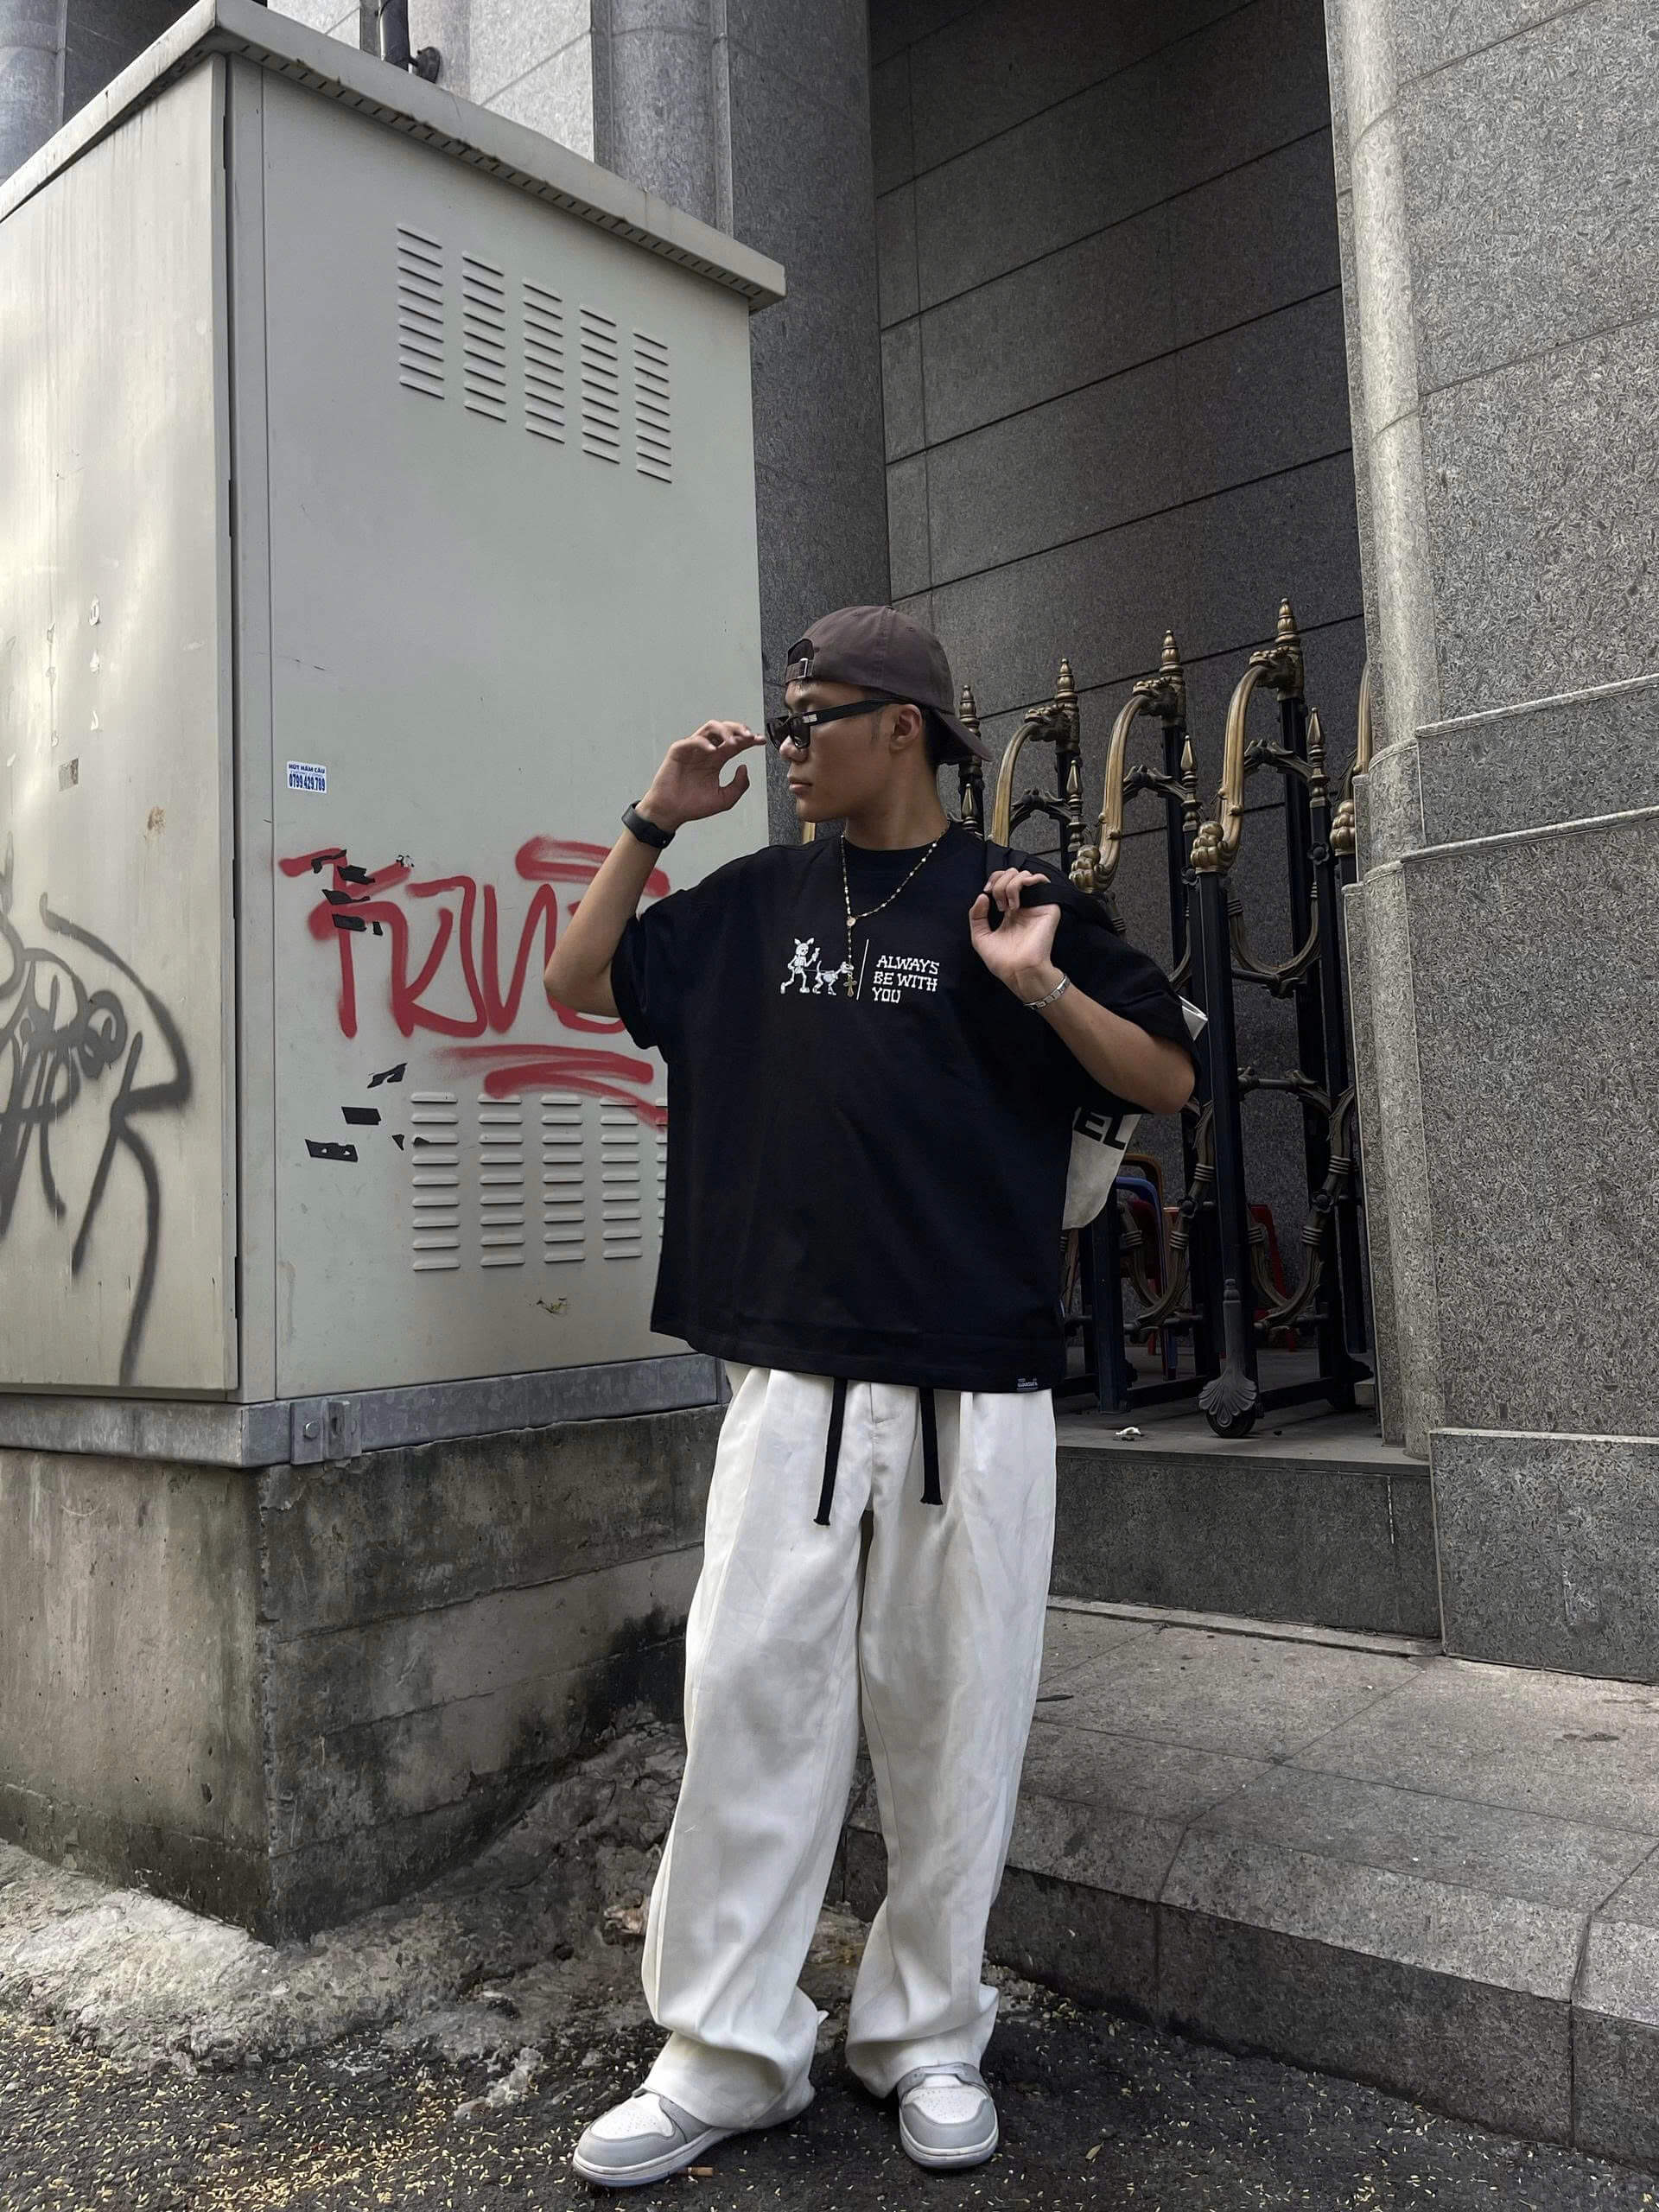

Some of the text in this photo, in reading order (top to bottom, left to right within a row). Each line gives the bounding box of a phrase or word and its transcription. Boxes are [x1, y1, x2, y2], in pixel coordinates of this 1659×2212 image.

[876, 955, 940, 974] ALWAYS
[873, 970, 938, 992] BE WITH
[871, 986, 902, 1003] YOU
